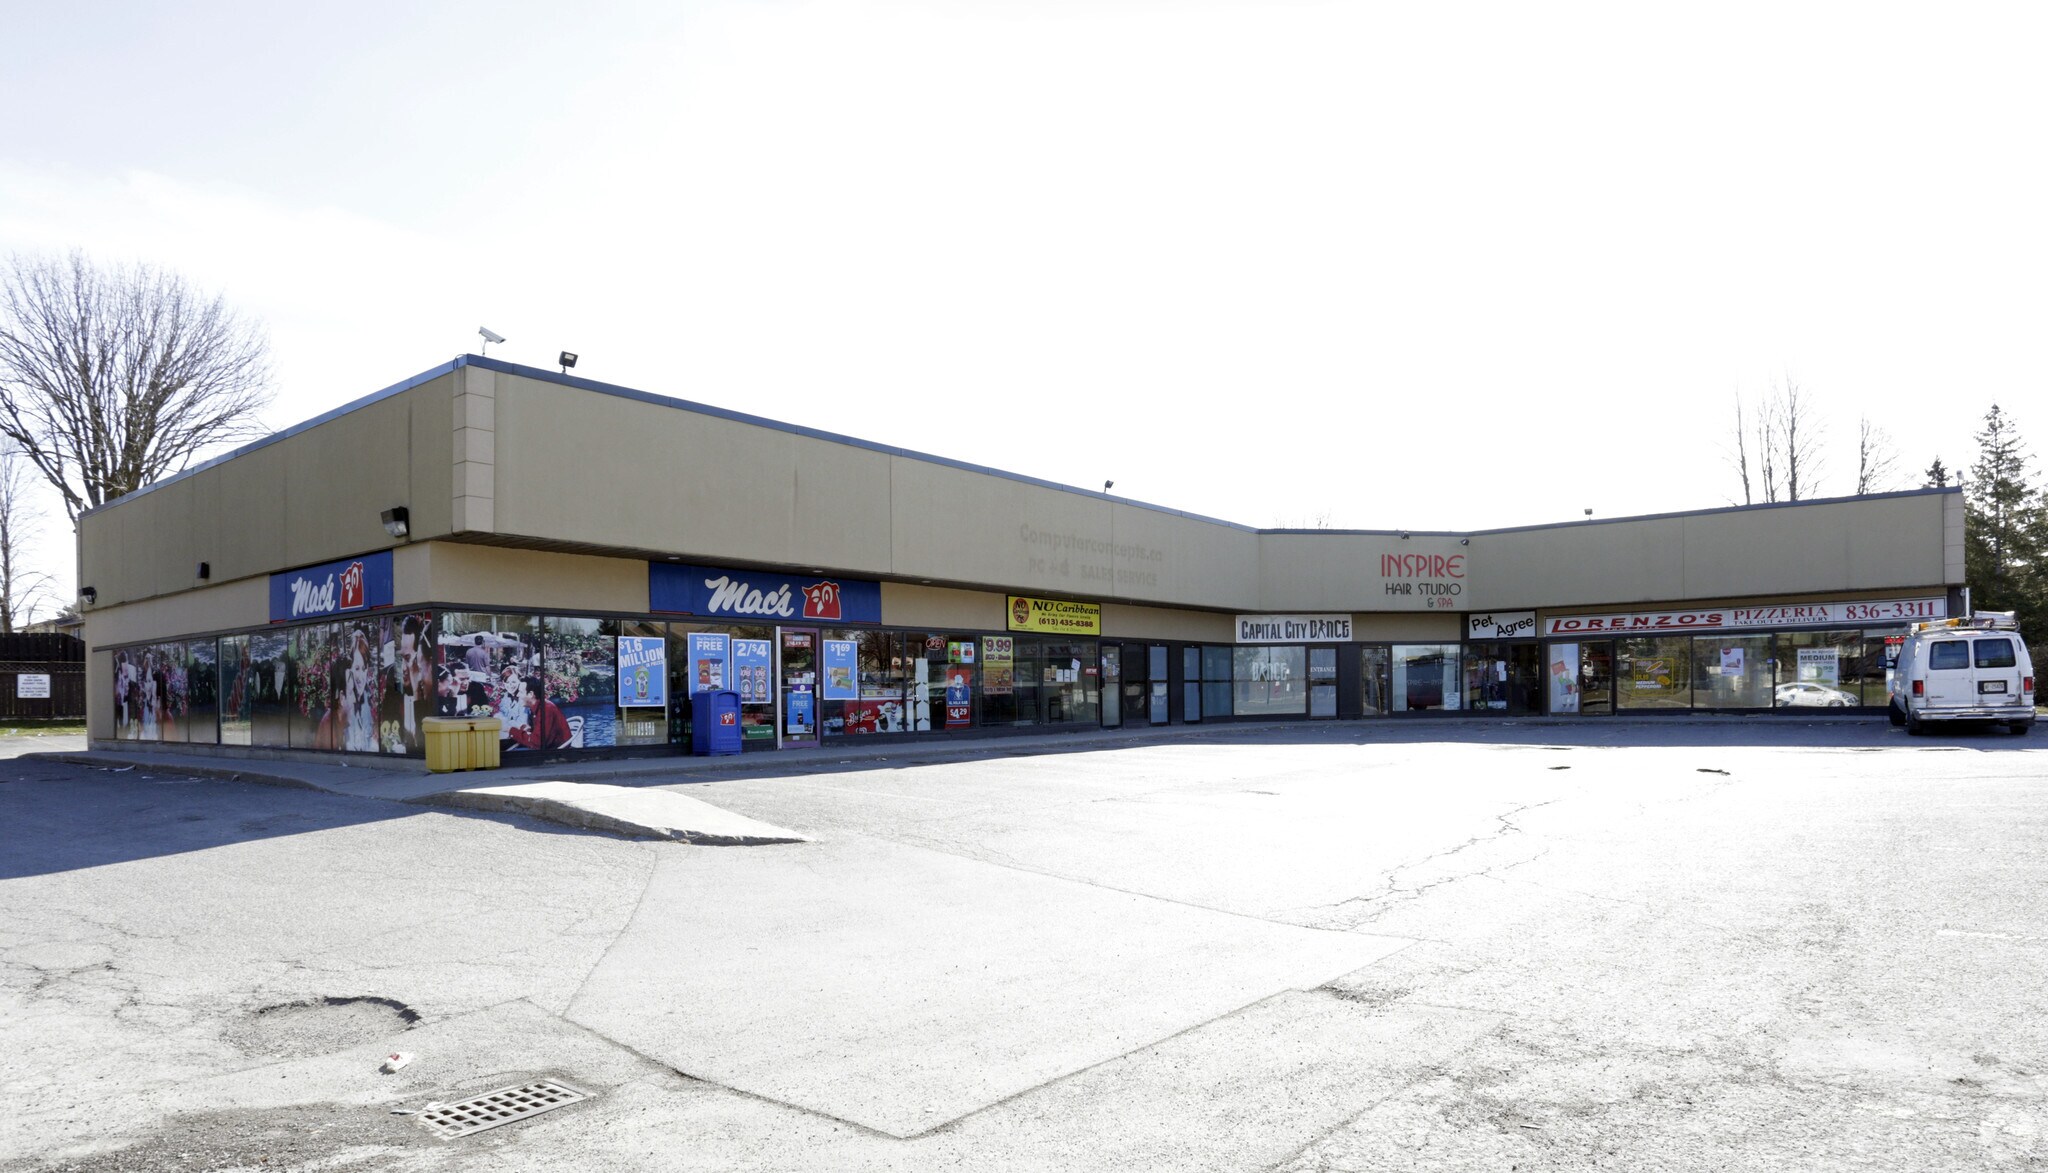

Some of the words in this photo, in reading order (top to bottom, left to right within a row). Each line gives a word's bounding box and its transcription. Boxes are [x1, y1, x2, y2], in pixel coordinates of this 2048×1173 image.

[1381, 554, 1466, 578] INSPIRE
[1080, 564, 1113, 582] SALES
[1117, 568, 1158, 585] SERVICE
[291, 573, 336, 617] Mac's
[704, 575, 795, 617] Mac's
[1385, 583, 1412, 596] HAIR
[1418, 583, 1461, 596] STUDIO
[1056, 603, 1100, 615] Caribbean
[1427, 597, 1435, 609] &
[1437, 598, 1454, 608] SPA
[1038, 617, 1058, 626] (613)
[1060, 619, 1094, 628] 435-8388
[1551, 613, 1724, 634] LORENZO'S
[1734, 606, 1829, 621] PIZZERIA
[1846, 601, 1936, 619] 836-3311
[1787, 616, 1829, 624] DELIVERY
[1241, 620, 1283, 640] CAPITAL
[1285, 620, 1308, 639] CITY
[1496, 617, 1534, 637] Agree
[619, 638, 643, 654] $1.6
[697, 641, 723, 651] FREE
[737, 643, 767, 657] 2/$4
[925, 638, 947, 648] OPEN
[620, 647, 664, 668] MILLION
